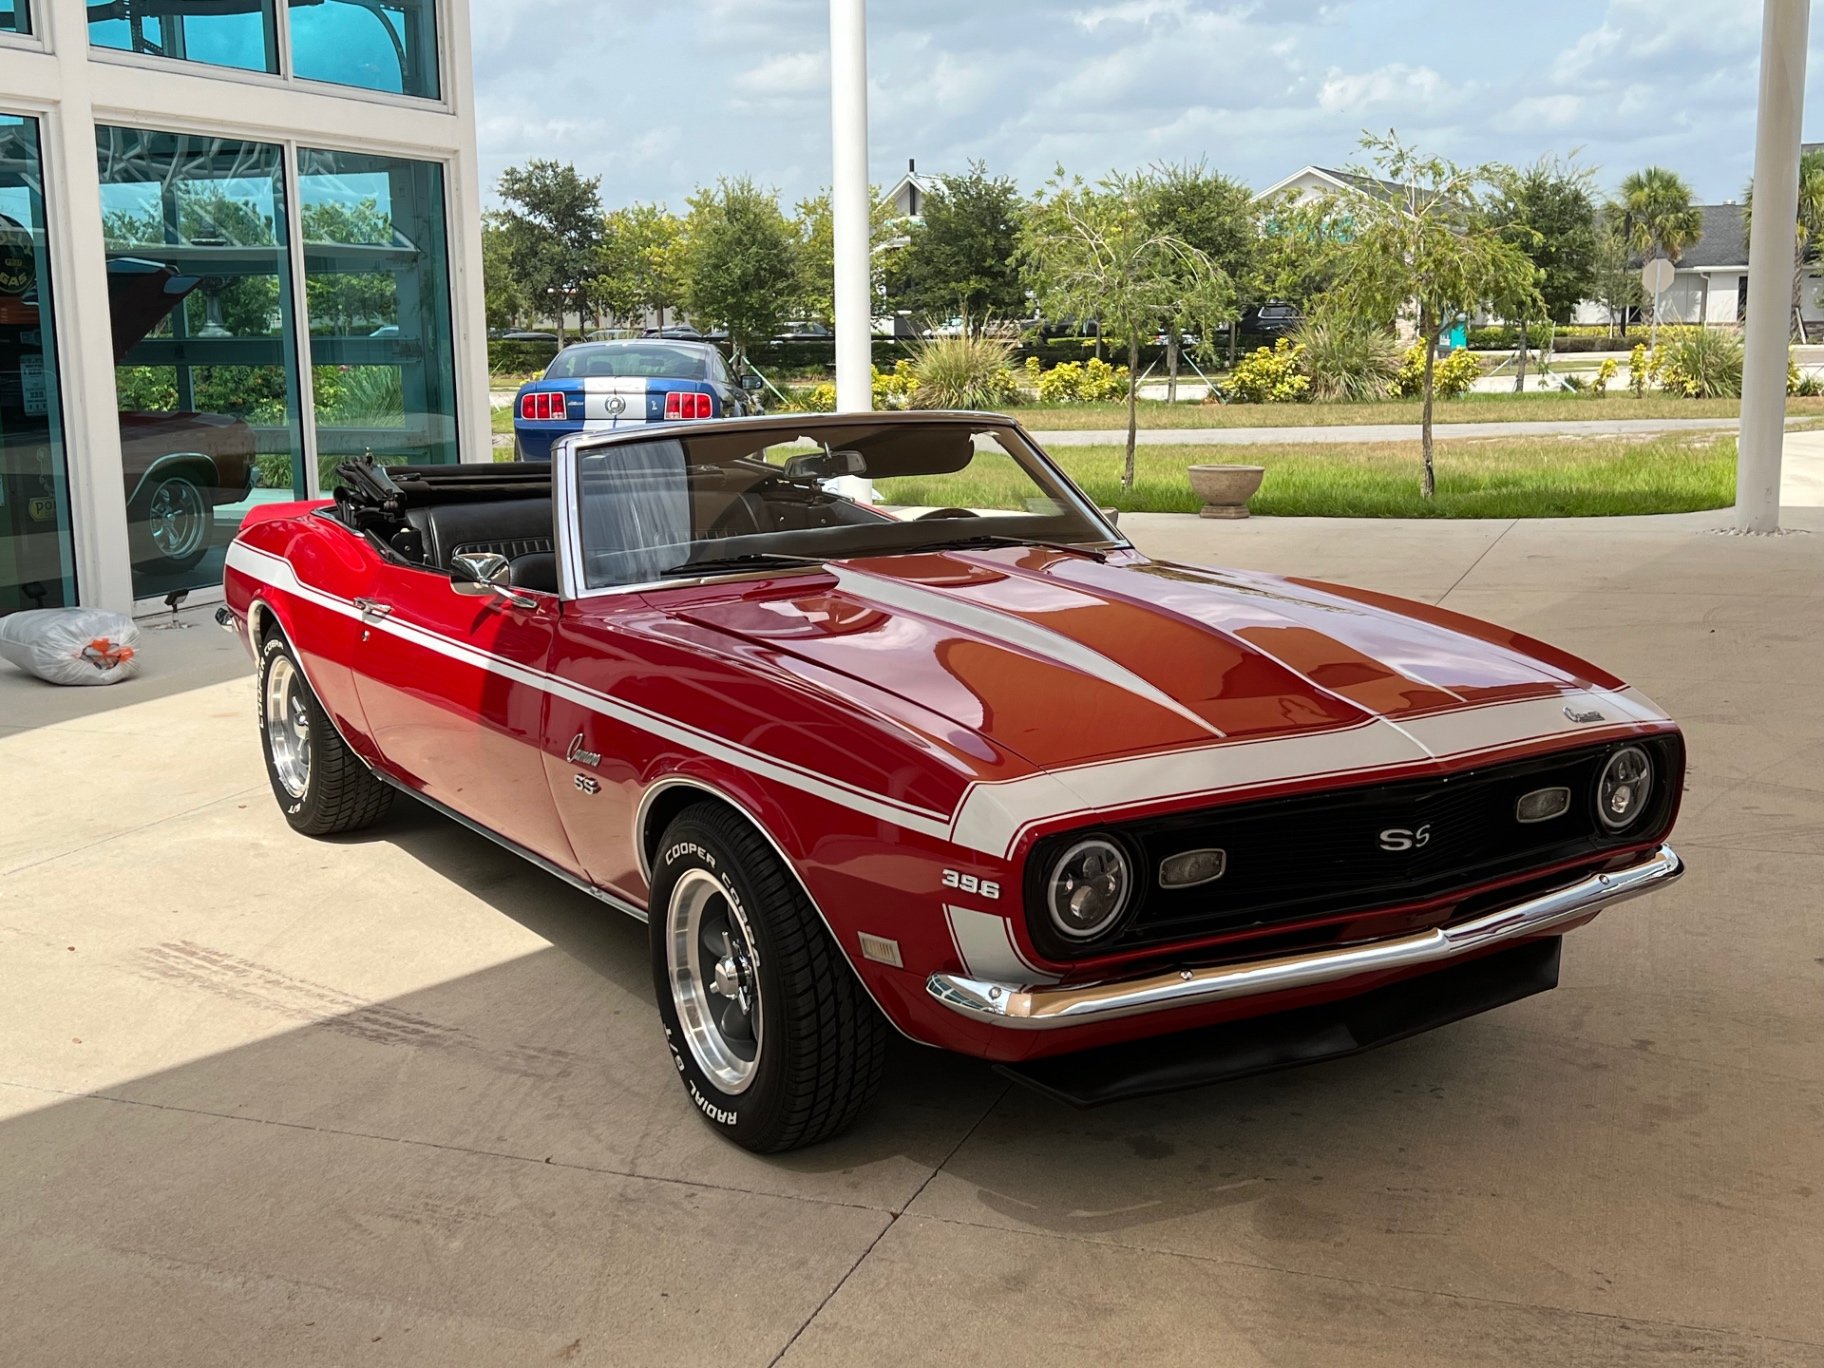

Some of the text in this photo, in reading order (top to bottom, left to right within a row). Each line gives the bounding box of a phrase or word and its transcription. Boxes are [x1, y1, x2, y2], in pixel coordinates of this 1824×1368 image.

[574, 773, 600, 795] SS
[1379, 824, 1431, 851] SS
[665, 842, 716, 869] COOPER
[941, 868, 1000, 900] 396
[689, 1079, 738, 1125] RADIAL
